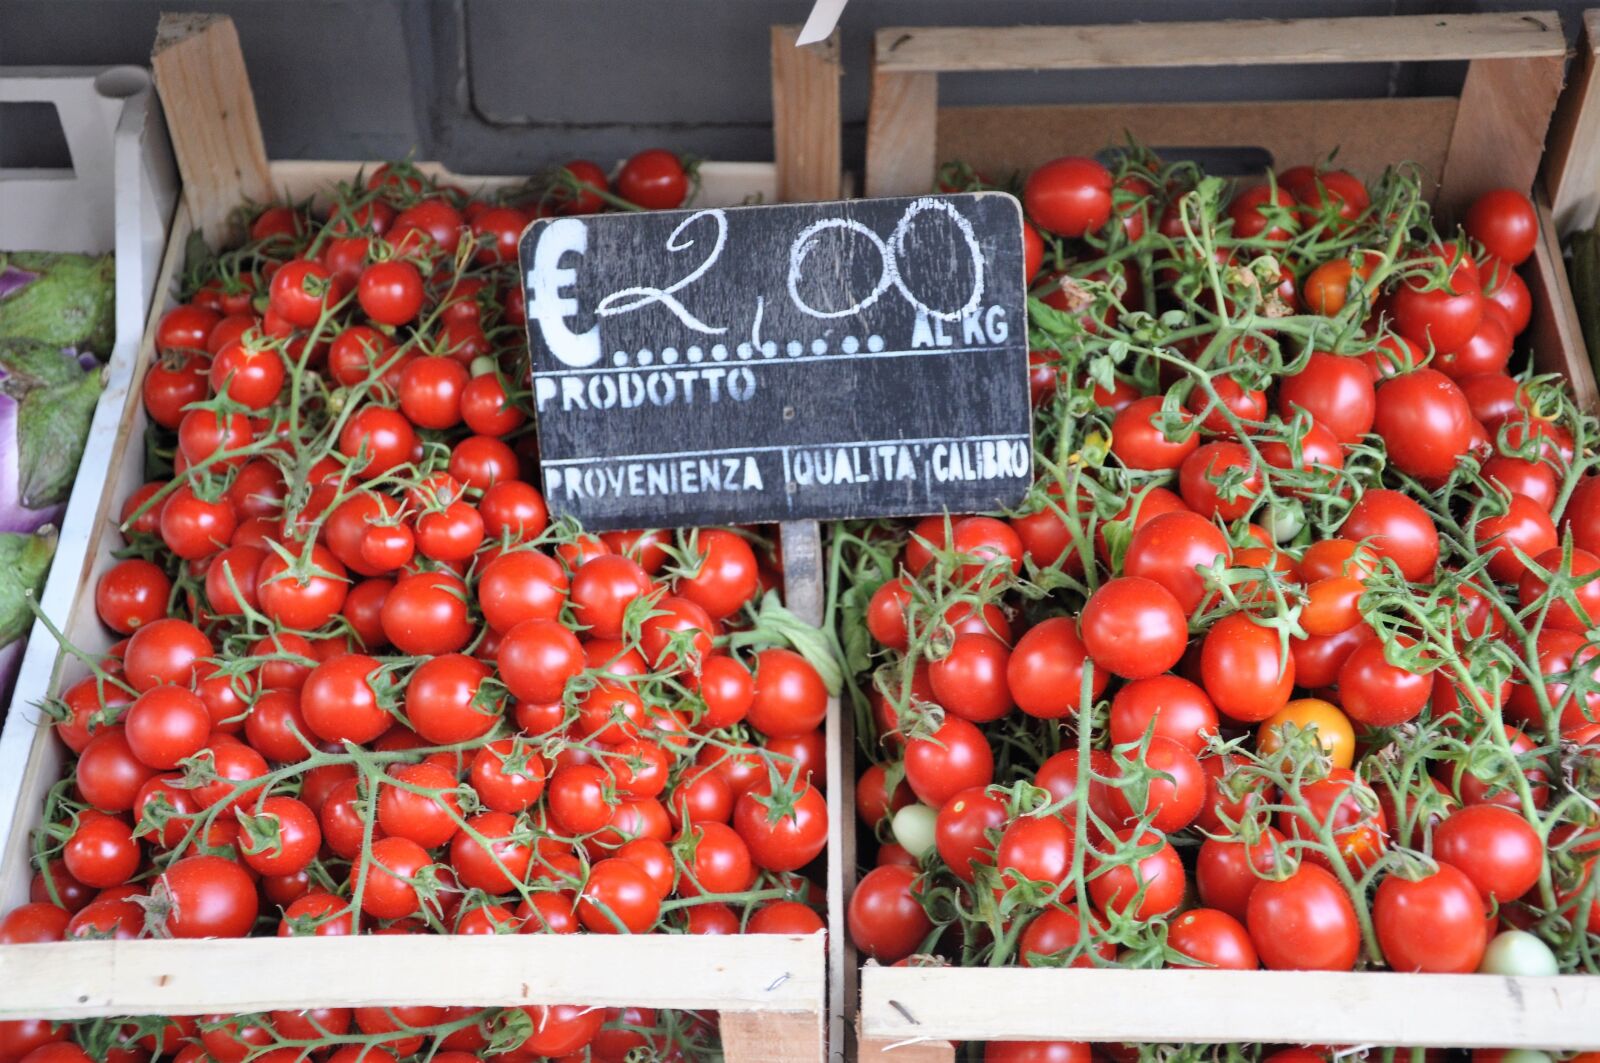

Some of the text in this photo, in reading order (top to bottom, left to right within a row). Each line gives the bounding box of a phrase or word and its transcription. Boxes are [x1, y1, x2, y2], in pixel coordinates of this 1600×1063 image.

[911, 304, 1009, 348] AL KG
[534, 366, 757, 413] PRODOTTO
[544, 456, 764, 501] PROVENIENZA
[931, 439, 1029, 483] CALIBRO
